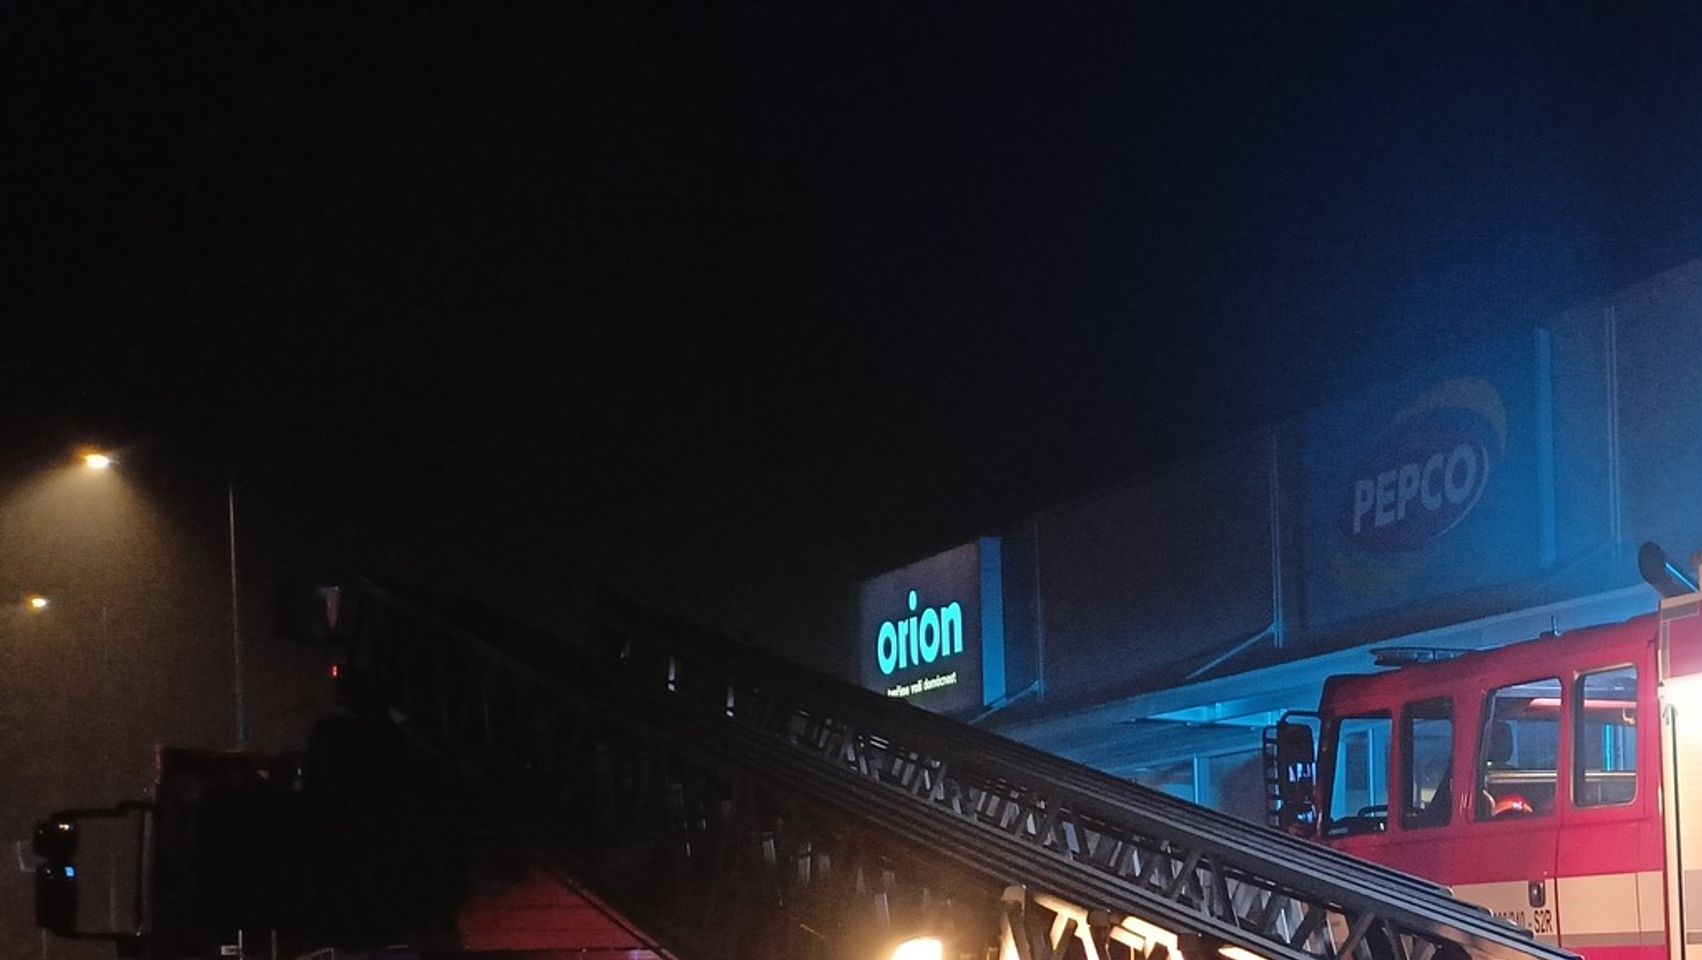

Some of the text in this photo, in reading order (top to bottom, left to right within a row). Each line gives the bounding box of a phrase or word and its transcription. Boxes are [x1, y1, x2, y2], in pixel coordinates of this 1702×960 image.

[1352, 444, 1476, 534] PEPCO
[877, 590, 964, 675] orion
[1533, 909, 1553, 933] S2R
